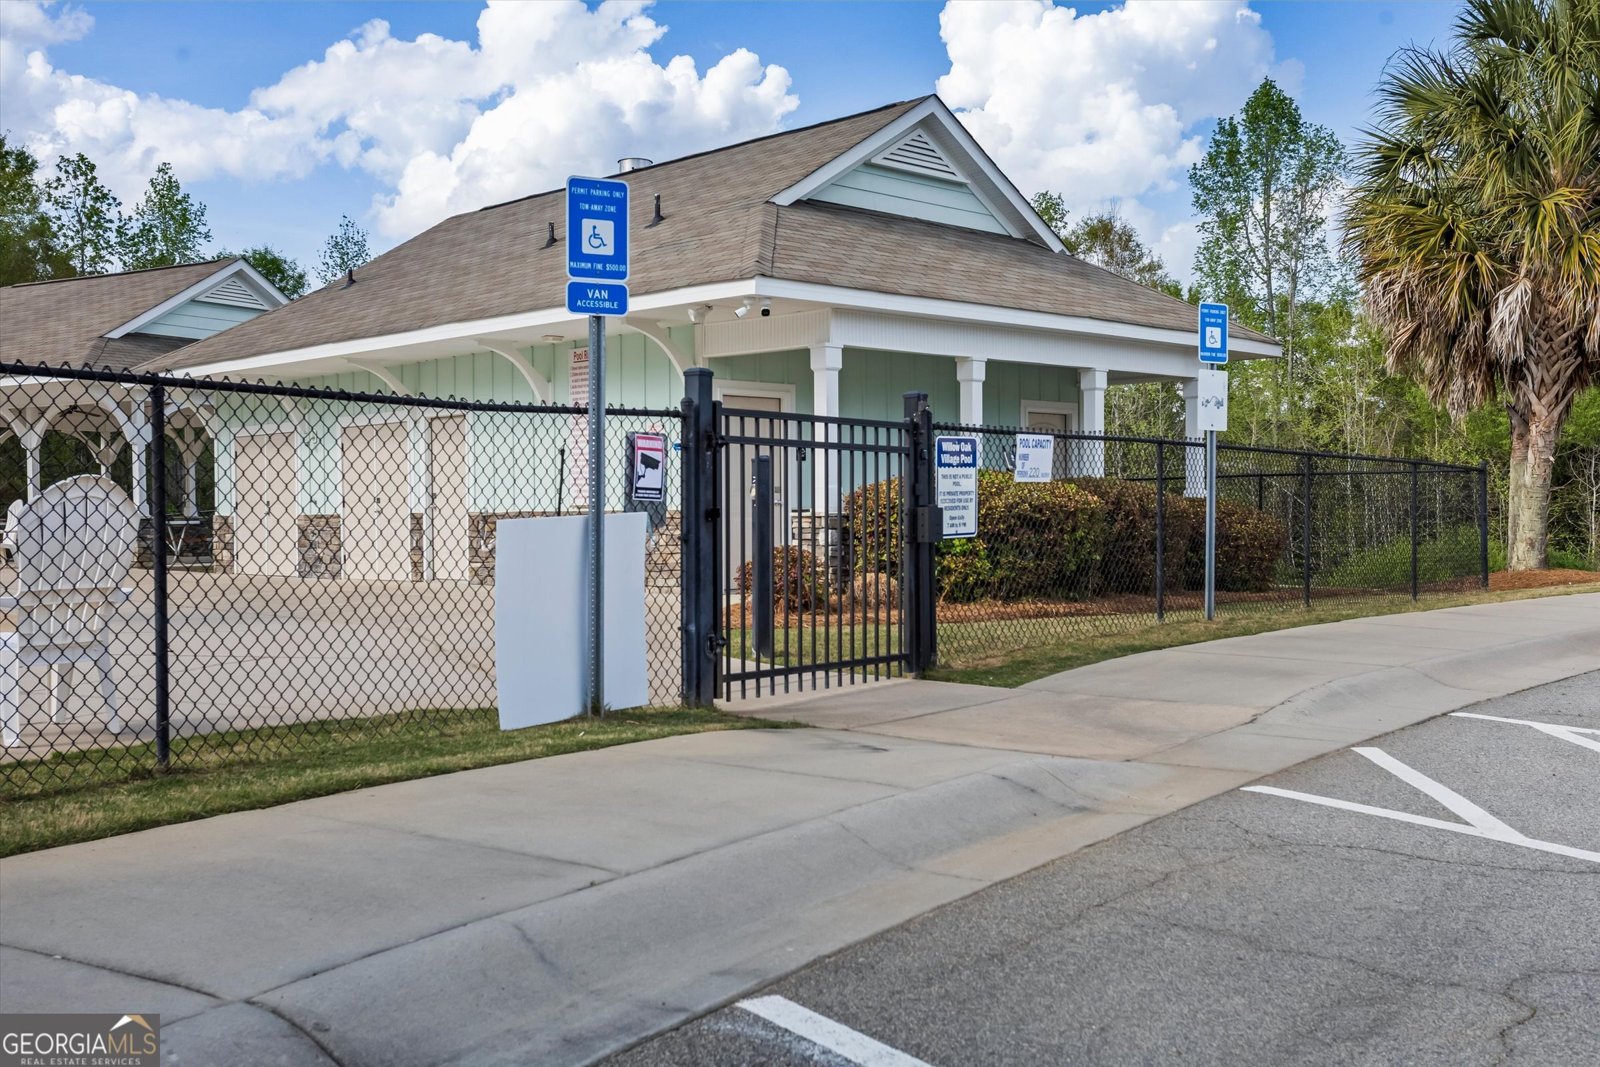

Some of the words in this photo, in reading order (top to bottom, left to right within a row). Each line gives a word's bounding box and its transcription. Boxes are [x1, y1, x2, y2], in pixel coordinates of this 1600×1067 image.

[571, 187, 588, 195] PERMIT
[590, 189, 610, 197] PARKING
[570, 261, 592, 270] MAXIMUM
[593, 262, 603, 270] FINE
[606, 264, 626, 272] $500.00
[587, 289, 608, 299] VAN
[577, 300, 619, 309] ACCESSIBLE
[942, 441, 960, 451] Willow
[960, 442, 972, 452] Oak
[1020, 438, 1030, 448] POOL
[1032, 438, 1052, 449] CAPACITY
[941, 454, 960, 465] Village
[960, 454, 972, 464] Pool
